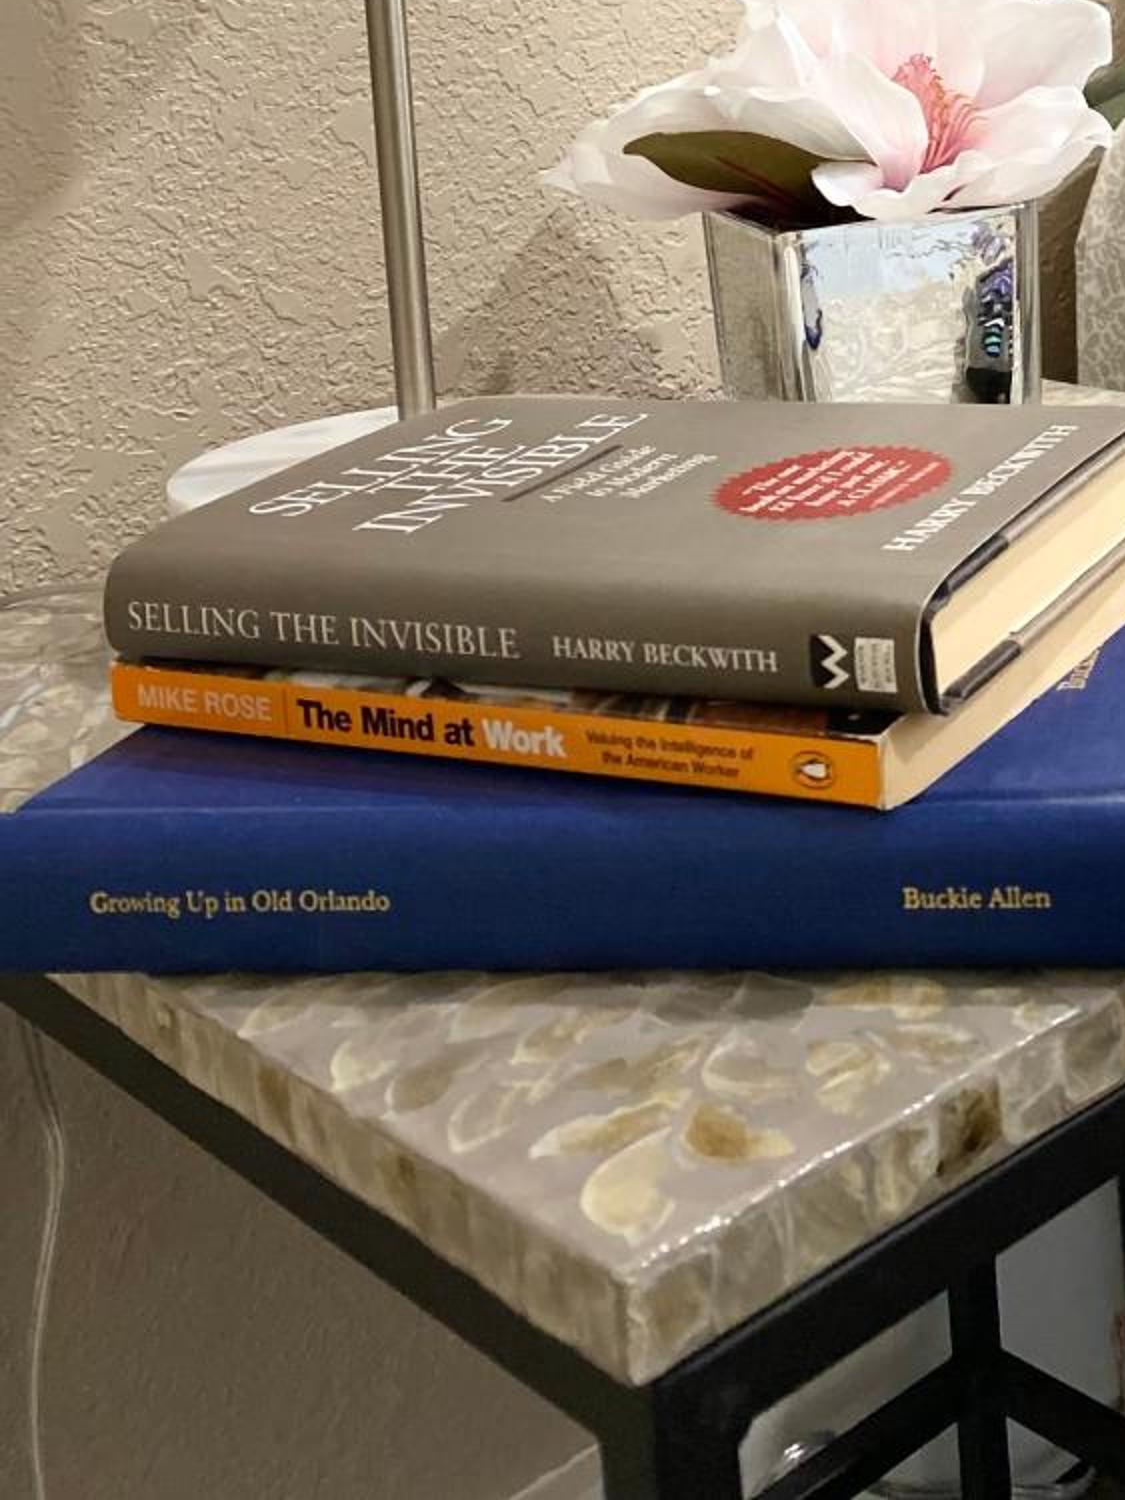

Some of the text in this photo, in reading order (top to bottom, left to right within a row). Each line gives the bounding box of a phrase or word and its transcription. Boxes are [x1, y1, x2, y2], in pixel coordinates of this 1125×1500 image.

[249, 418, 513, 517] SELLING
[352, 413, 649, 534] INVISIBLE
[365, 445, 526, 494] THE
[880, 497, 978, 551] HARRY
[960, 424, 1080, 496] BECKWITH
[127, 599, 522, 660] SELLING THE INVISIBLE
[552, 635, 779, 673] HARRY BECKWITH
[136, 683, 273, 722] MIKE ROSE
[296, 699, 567, 758] The Mind at Work
[636, 734, 656, 750] the
[602, 750, 740, 778] the American Worker
[90, 889, 391, 919] Growing Up in Old Orlando
[902, 884, 1053, 910] Buckie Allen
